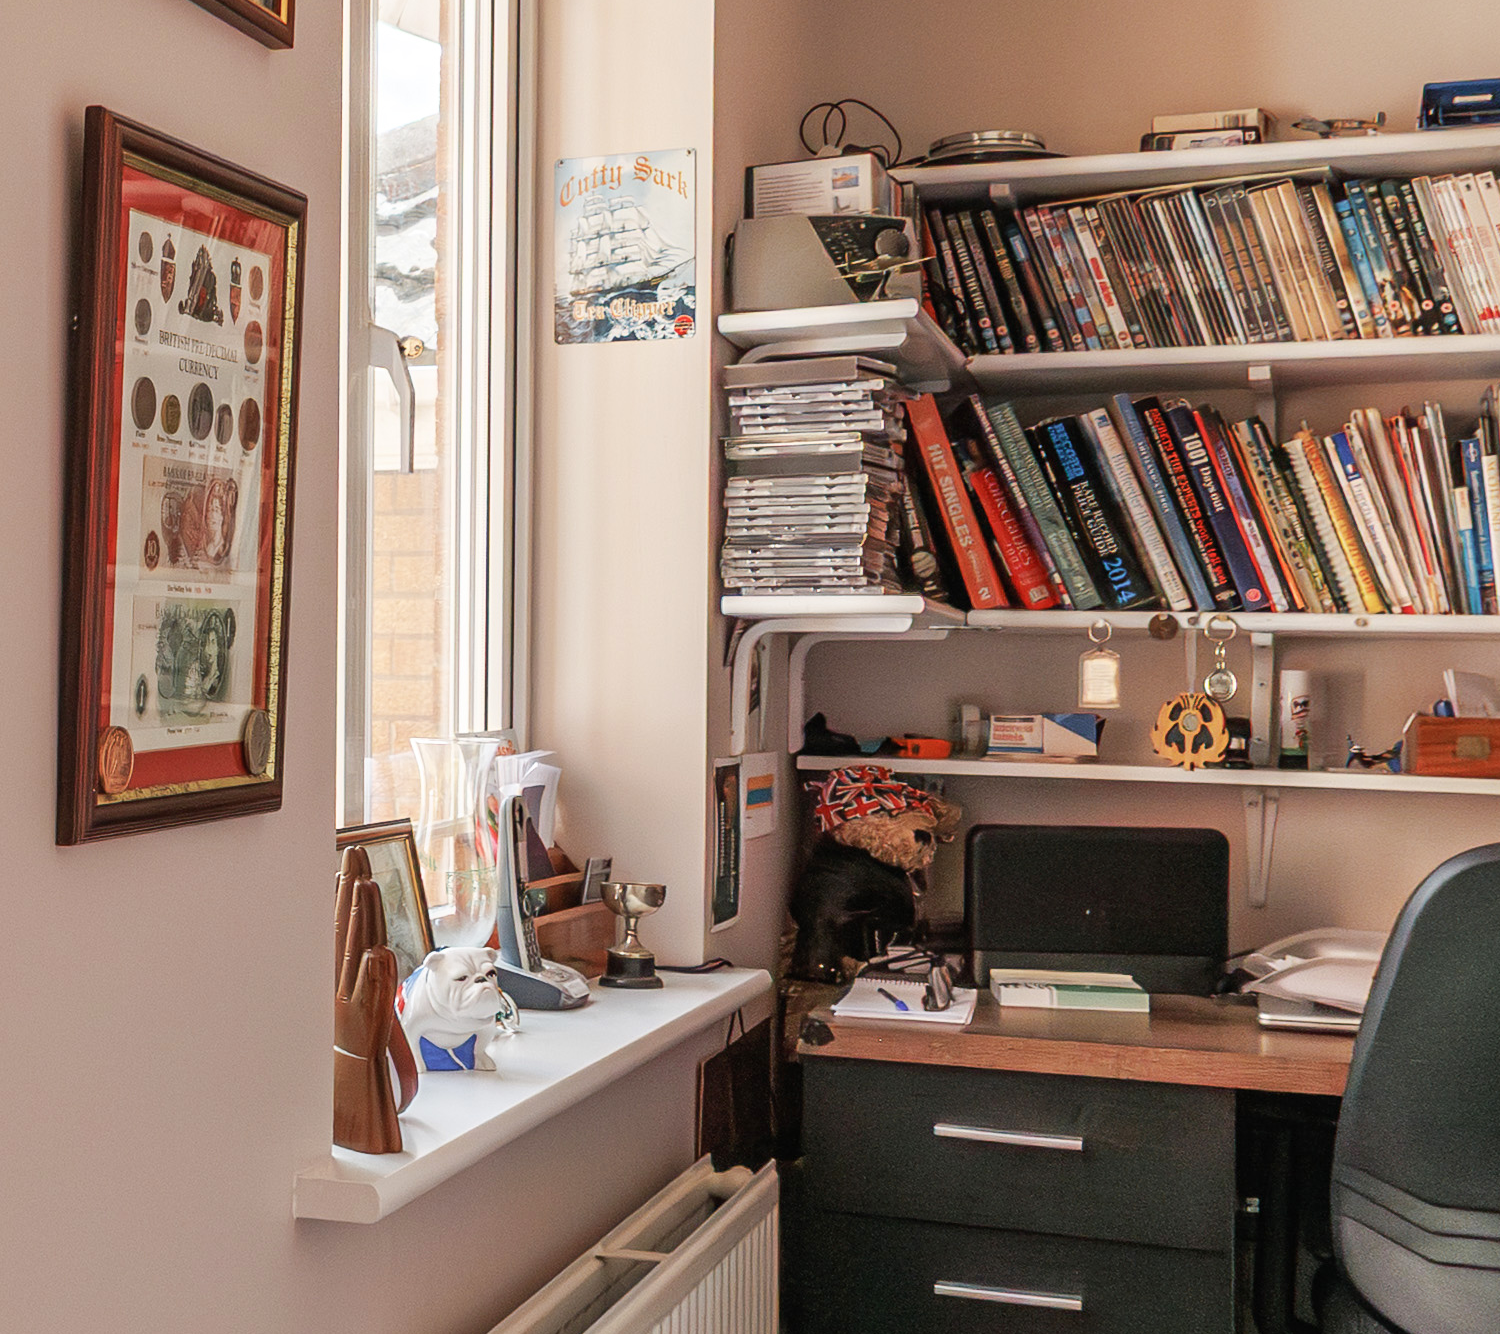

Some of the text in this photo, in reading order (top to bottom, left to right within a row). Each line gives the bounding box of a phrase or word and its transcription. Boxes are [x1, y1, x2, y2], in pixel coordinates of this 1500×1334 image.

[559, 156, 688, 207] Cutty Sark
[572, 297, 677, 321] Tea Clipper
[159, 330, 190, 351] BRITISH
[178, 358, 219, 380] CURRENCY
[1182, 432, 1209, 466] 1001
[1200, 465, 1220, 492] Days
[1210, 492, 1226, 512] out
[927, 443, 992, 602] HIT SINGLES 2
[1080, 480, 1119, 554] RARE RECORD
[1166, 451, 1183, 474] THE
[1175, 472, 1201, 519] EXPERTS
[1194, 517, 1213, 548] won't
[1086, 517, 1110, 557] GUIDE
[1103, 556, 1137, 605] 2014
